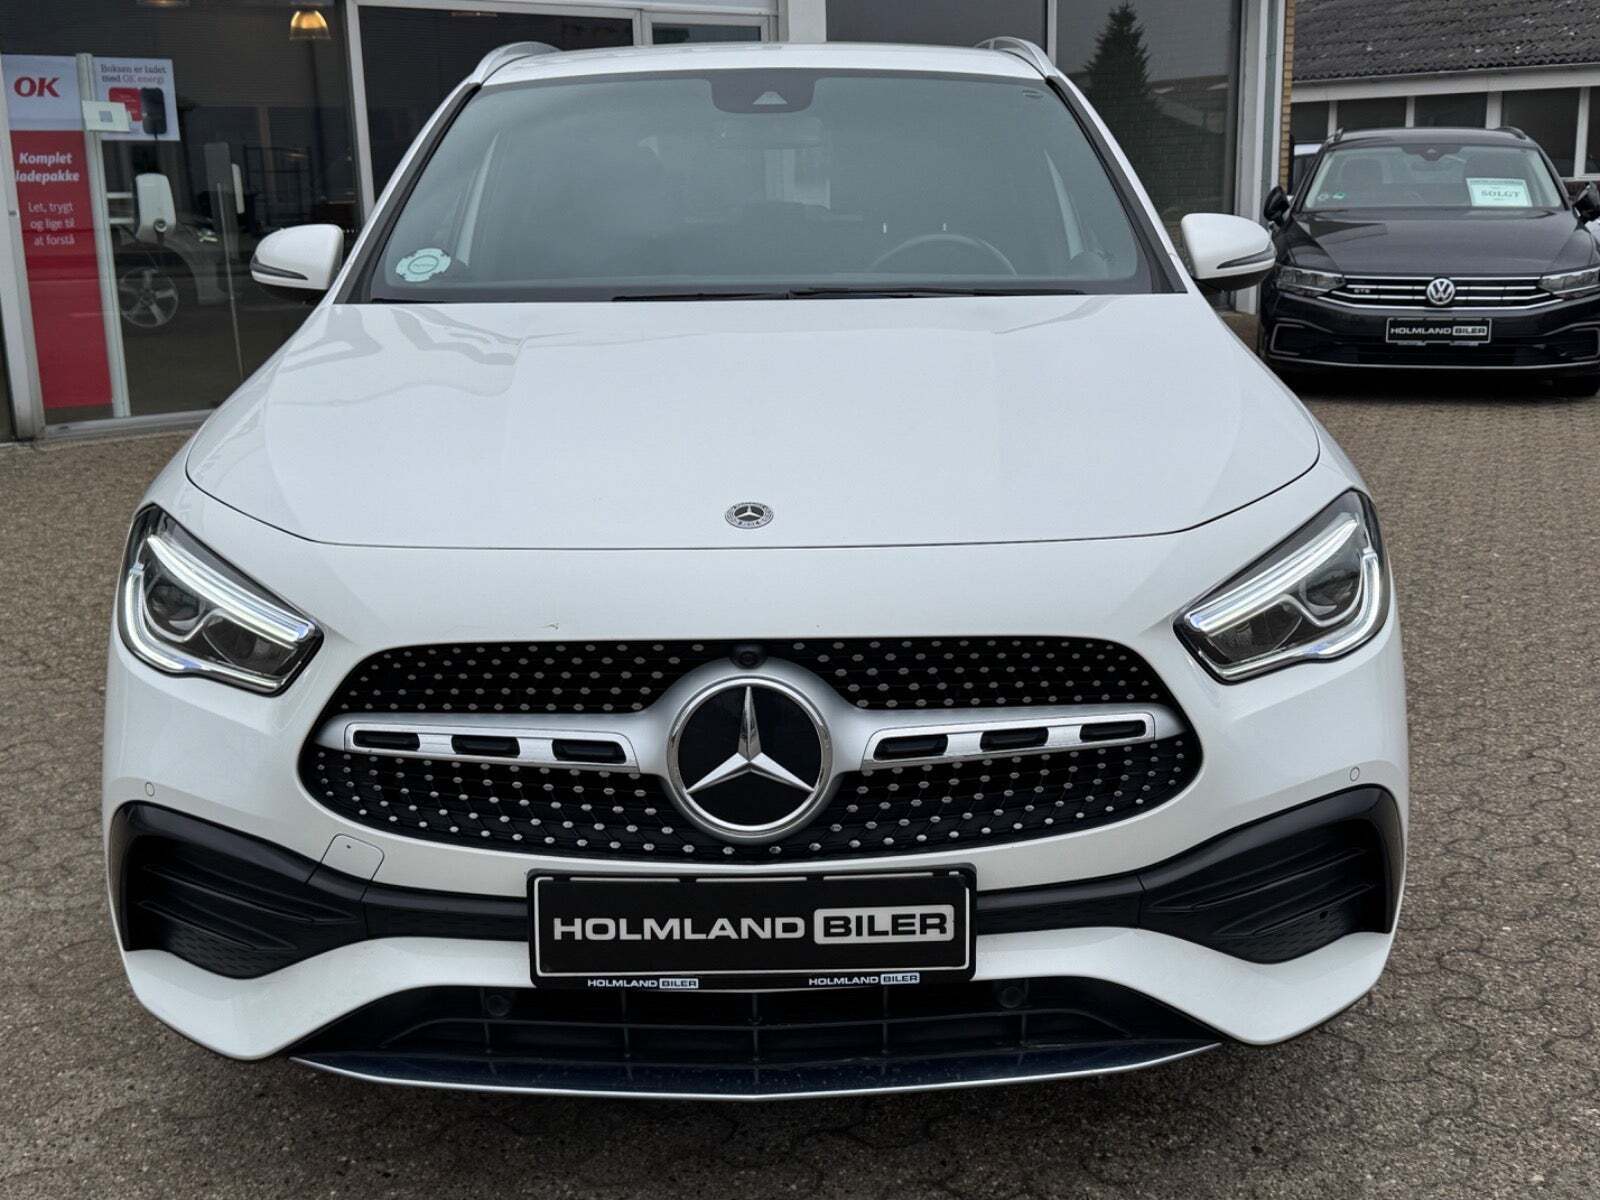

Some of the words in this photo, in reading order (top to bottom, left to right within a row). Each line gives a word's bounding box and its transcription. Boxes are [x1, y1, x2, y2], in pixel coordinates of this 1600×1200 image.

[14, 76, 61, 98] OK
[19, 152, 73, 167] Komplet
[16, 169, 80, 186] ladepakke
[1480, 190, 1520, 198] SOLGT
[28, 202, 47, 213] Let,
[49, 202, 74, 215] trygt
[30, 221, 44, 232] og
[46, 219, 63, 231] lige
[64, 218, 75, 228] til
[34, 236, 44, 246] at
[46, 234, 75, 245] forstå
[1390, 326, 1451, 335] HOLMLAND
[1454, 327, 1487, 335] BILER
[553, 917, 806, 941] HOLMLAND
[823, 912, 949, 938] BILER
[587, 978, 658, 988] HOLMLAND
[661, 979, 698, 988] BILER
[807, 976, 879, 986] HOLMLAND
[882, 974, 919, 984] BILER
